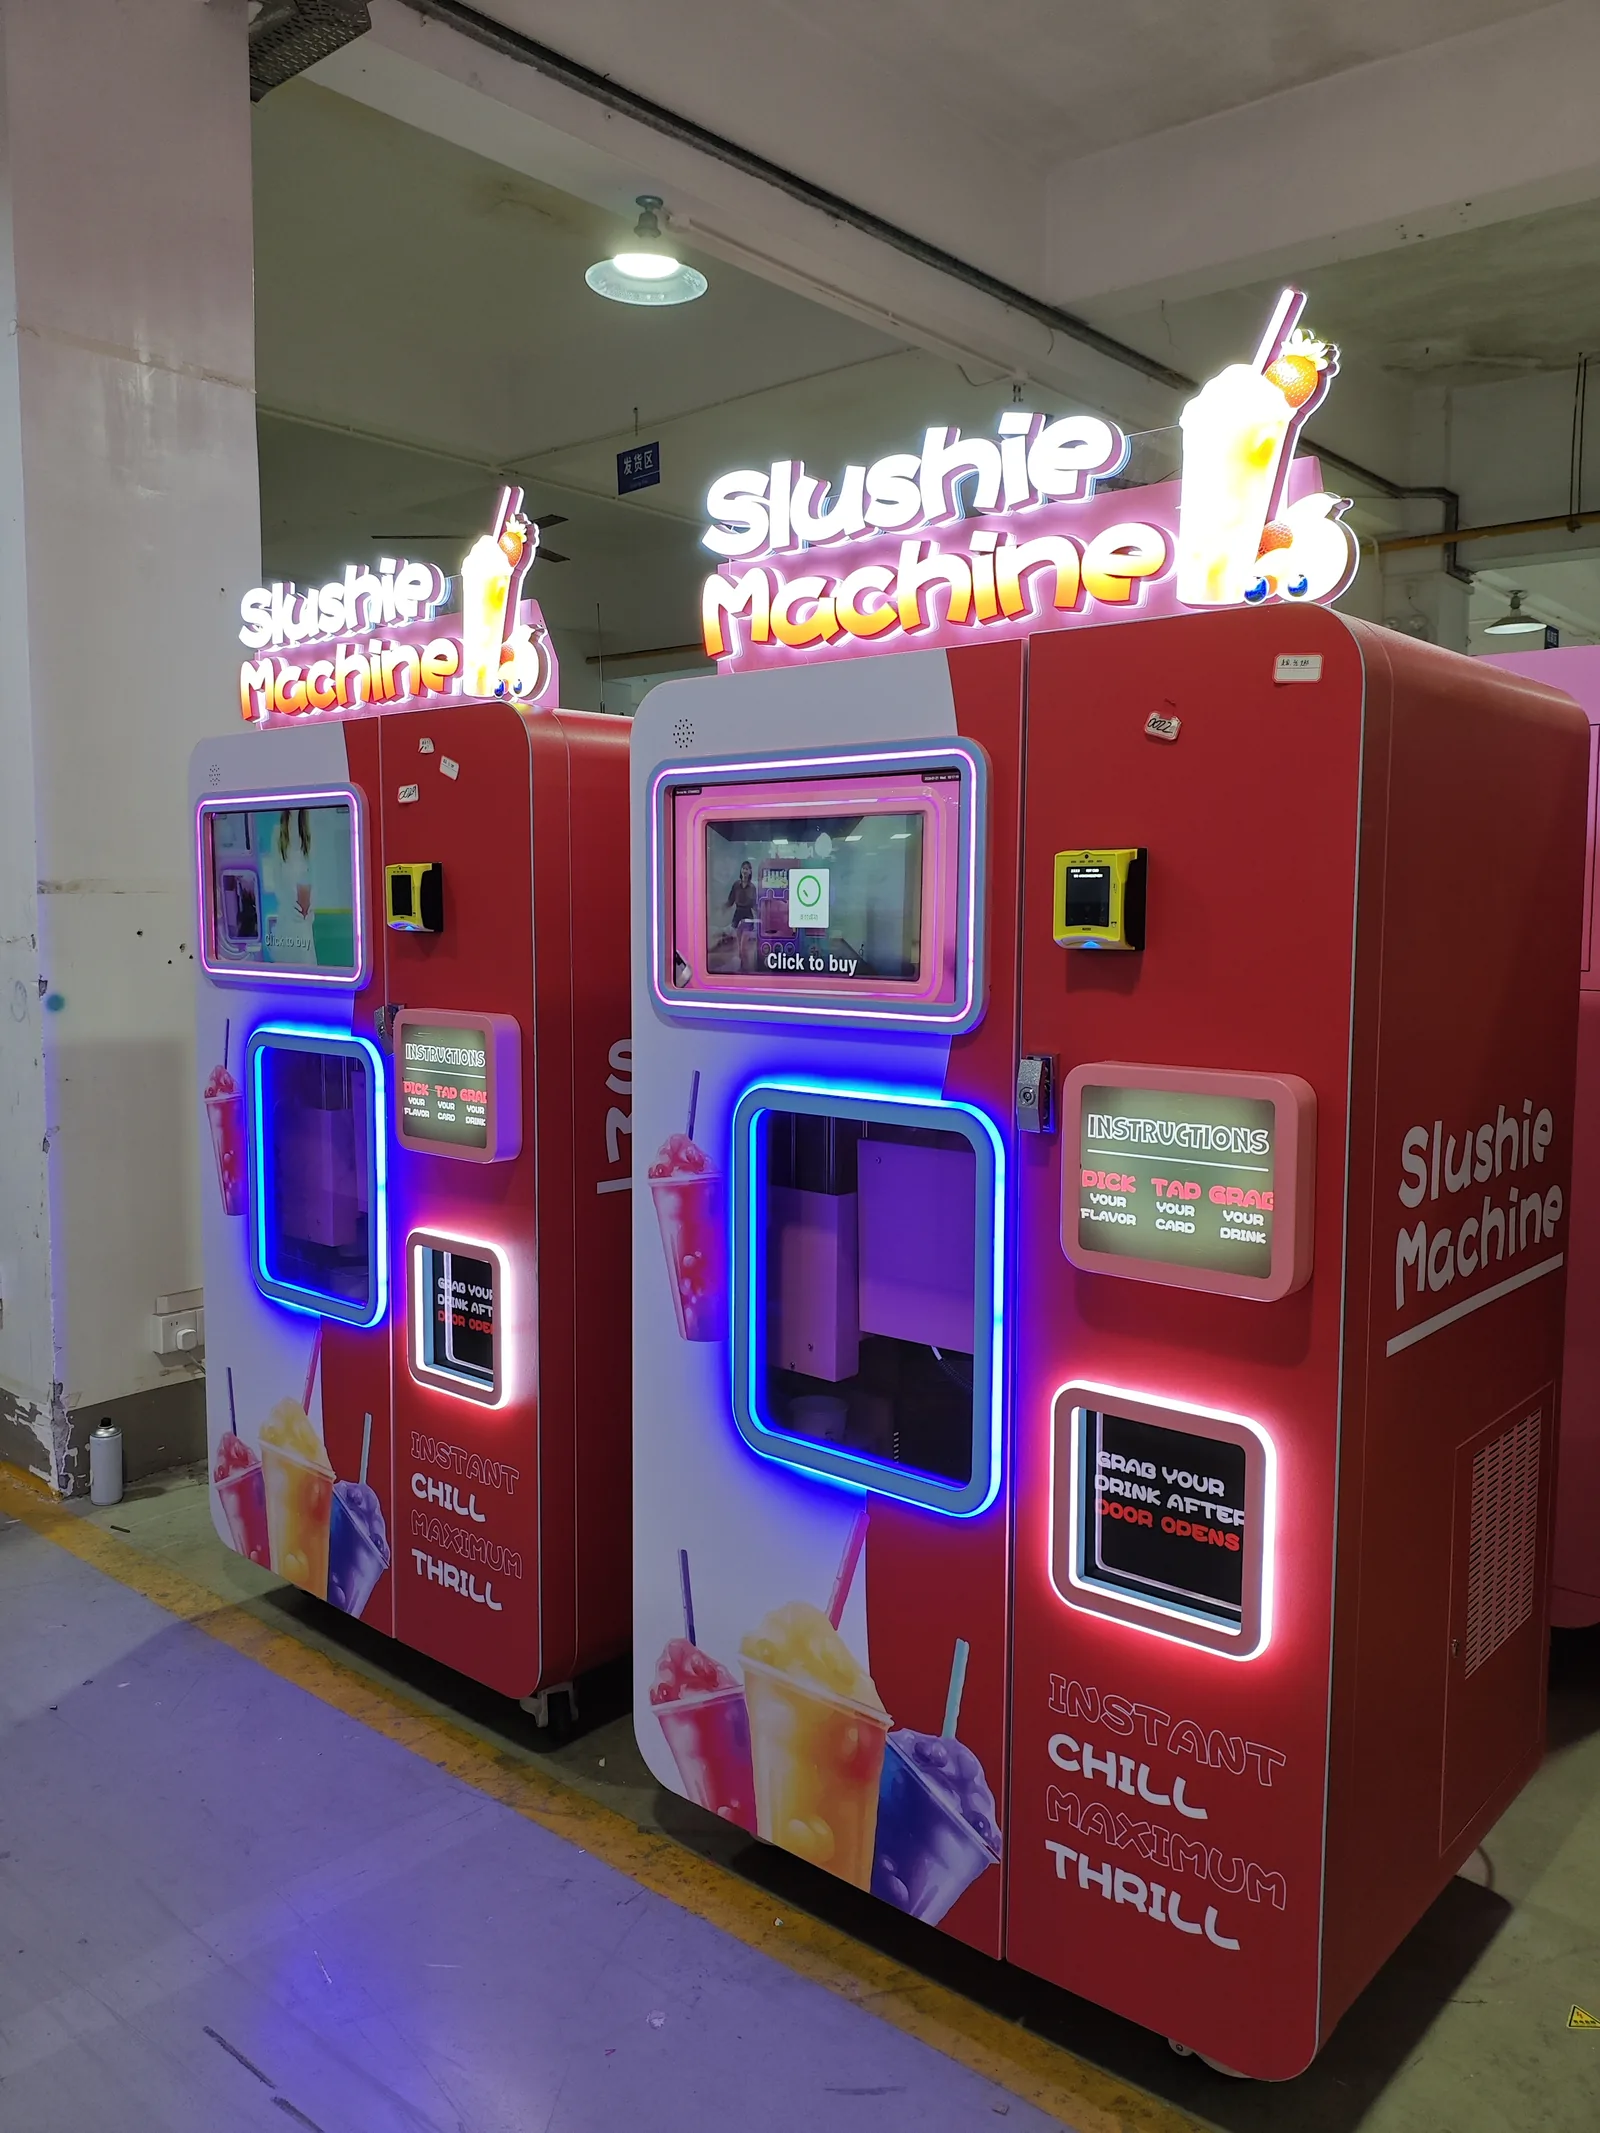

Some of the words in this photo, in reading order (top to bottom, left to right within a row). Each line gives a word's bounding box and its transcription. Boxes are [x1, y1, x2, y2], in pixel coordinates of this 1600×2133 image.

[623, 450, 654, 476] 发货区
[702, 411, 1118, 558] Slushie
[239, 557, 438, 648] Slushie
[701, 521, 1167, 659] Machine
[240, 638, 461, 722] Machine
[767, 953, 804, 971] Click
[808, 955, 825, 972] to
[829, 956, 857, 976] buy
[405, 1043, 486, 1068] INSTRUCTIONS
[404, 1107, 430, 1118] FLAVOR
[437, 1112, 456, 1122] CARD
[465, 1116, 486, 1126] DRINK
[408, 1096, 426, 1106] YOUR
[437, 1101, 455, 1111] YOUR
[466, 1104, 485, 1115] YOUR
[1087, 1114, 1270, 1156] INSTRUCTIONS
[1398, 1098, 1553, 1208] Slushie
[1080, 1207, 1137, 1226] FLAVOR
[1155, 1218, 1195, 1235] CARD
[1220, 1227, 1266, 1244] DRINK
[1090, 1192, 1127, 1208] YOUR
[1156, 1201, 1195, 1217] YOUR
[1222, 1209, 1264, 1227] YOUR
[1395, 1185, 1563, 1311] Machine
[410, 1431, 519, 1495] INSTANT
[1094, 1474, 1162, 1506] DRINK
[1096, 1450, 1157, 1480] GRAB
[1162, 1466, 1225, 1498] YOUR
[411, 1472, 486, 1522] CHILL
[1094, 1498, 1153, 1528] DOOR
[410, 1509, 522, 1580] MAXIMUM
[411, 1549, 503, 1611] THRILL
[1049, 1673, 1287, 1787] INSTANT
[1048, 1733, 1208, 1820] CHILL
[1046, 1785, 1287, 1911] MAXIMUM
[1045, 1839, 1241, 1950] THRILL
